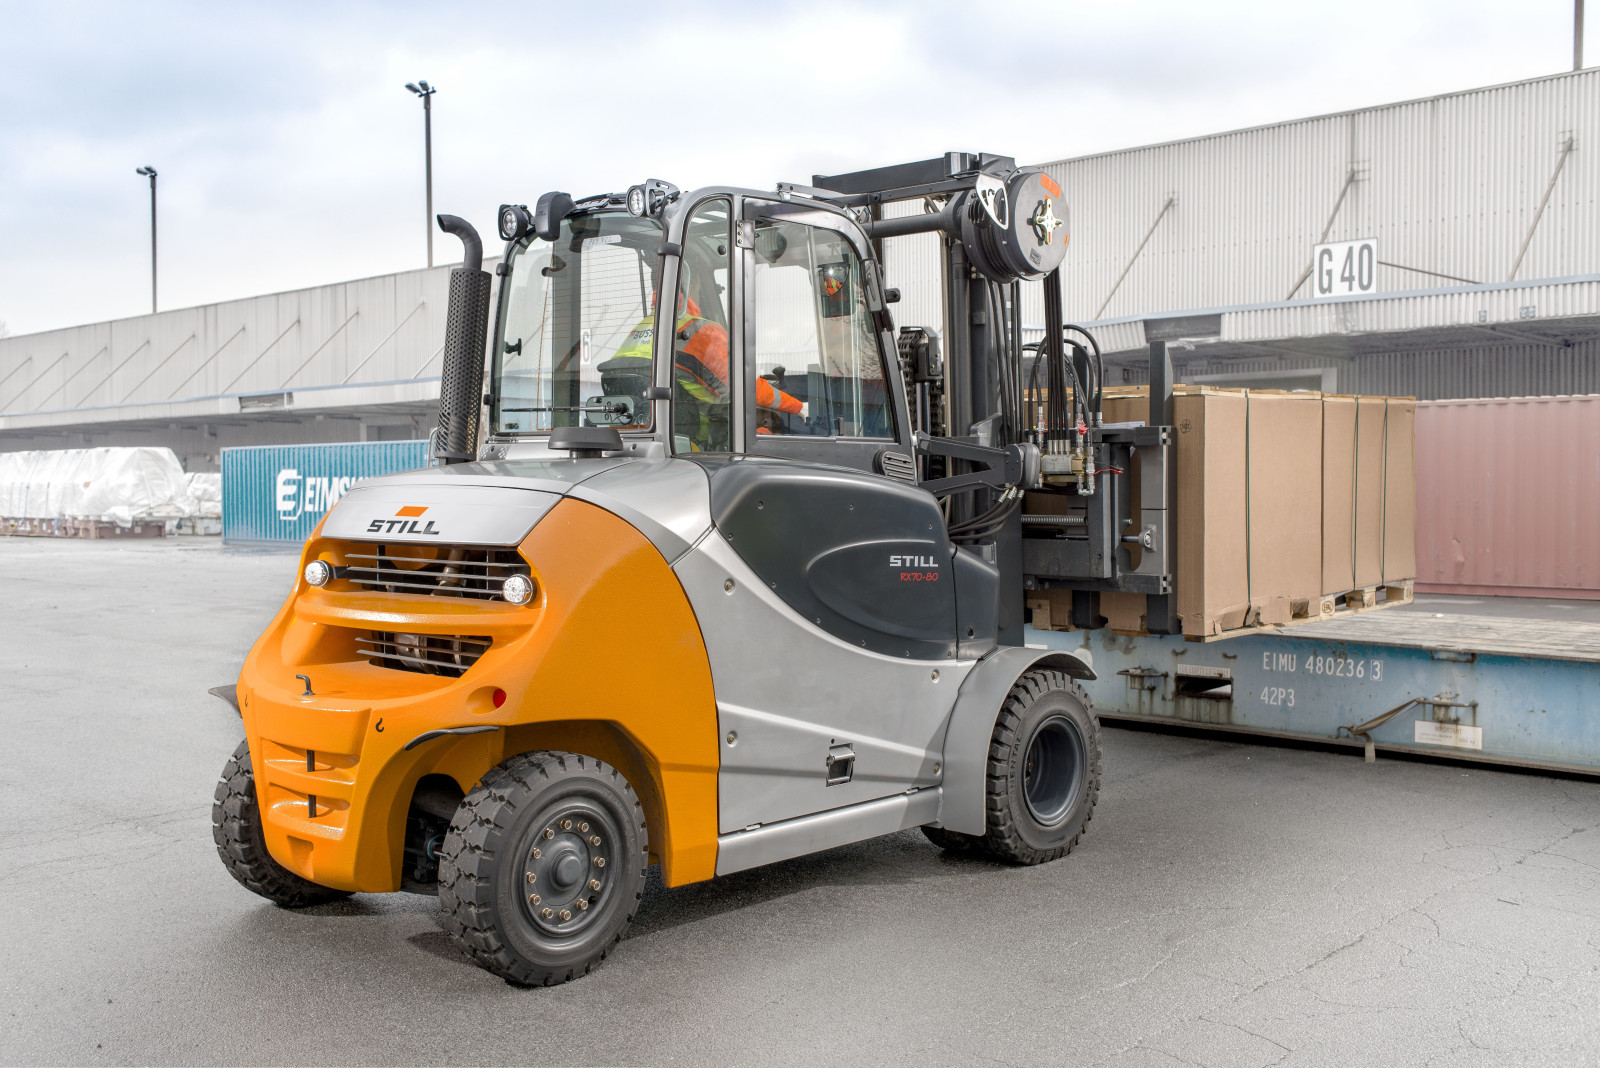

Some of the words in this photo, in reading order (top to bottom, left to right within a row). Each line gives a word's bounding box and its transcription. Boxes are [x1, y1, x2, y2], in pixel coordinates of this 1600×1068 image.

[1318, 248, 1333, 295] G
[1340, 243, 1373, 292] 40
[366, 519, 440, 535] STILL
[889, 555, 939, 567] STILL
[900, 572, 939, 581] RX70-80
[1263, 651, 1296, 672] EIMU
[1305, 655, 1364, 678] 480236
[1371, 660, 1382, 680] 3
[1260, 686, 1295, 707] 42P3
